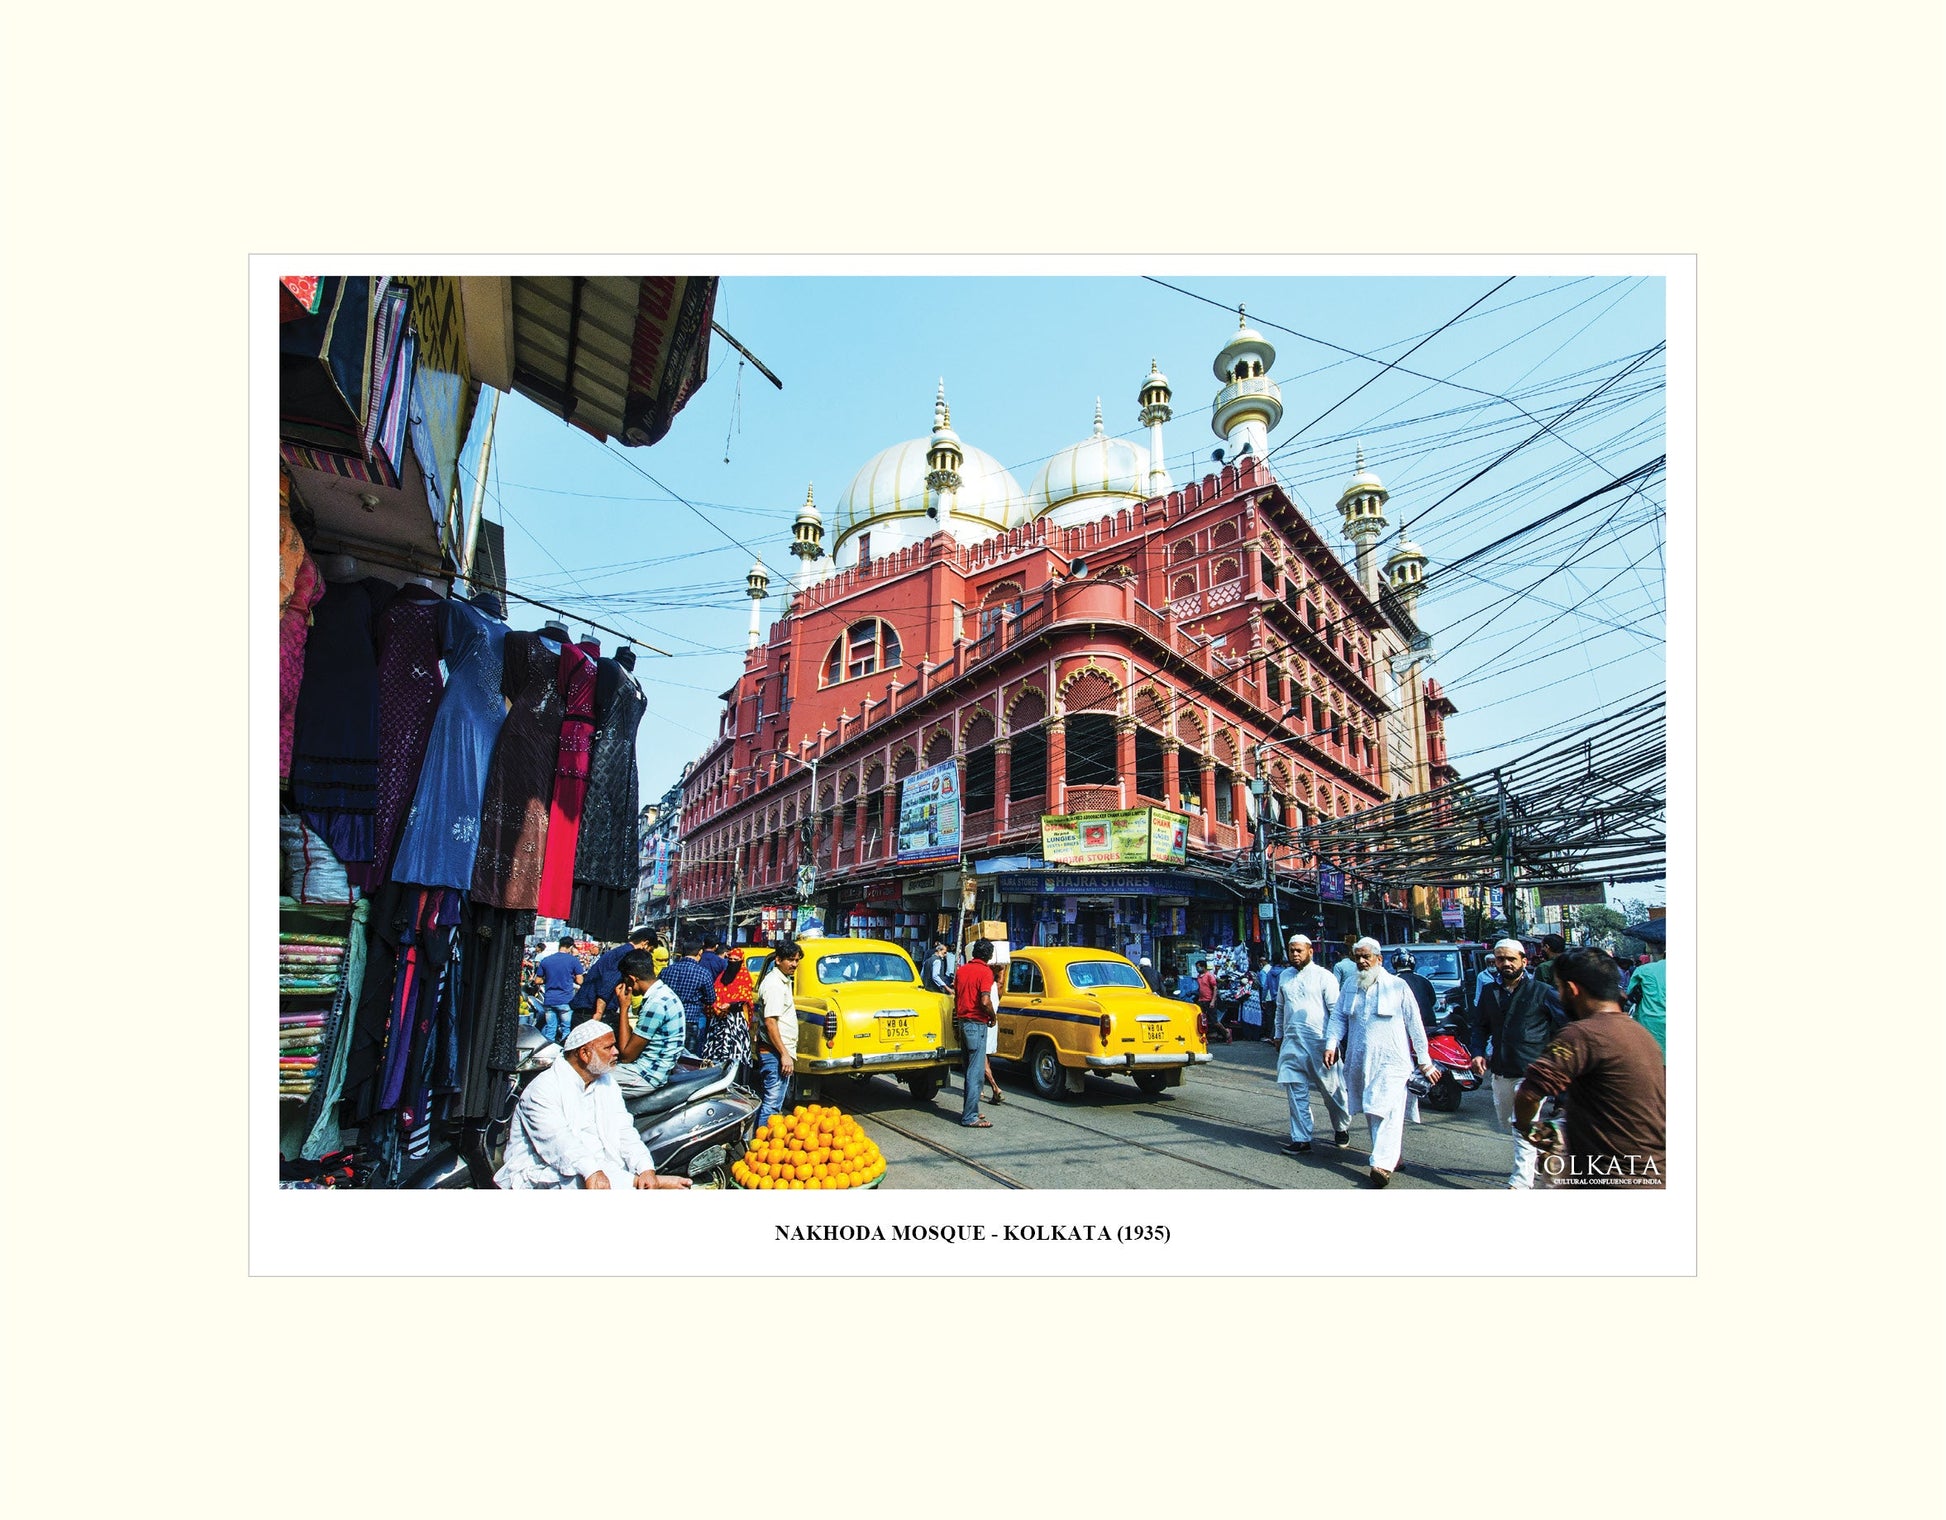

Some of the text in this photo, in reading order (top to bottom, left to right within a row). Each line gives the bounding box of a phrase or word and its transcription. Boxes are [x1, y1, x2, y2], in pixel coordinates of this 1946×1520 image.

[1046, 835, 1076, 843] LUNGIES
[1088, 852, 1120, 862] STORES
[1056, 876, 1150, 887] HAJRA STORES
[886, 1019, 896, 1027] WB
